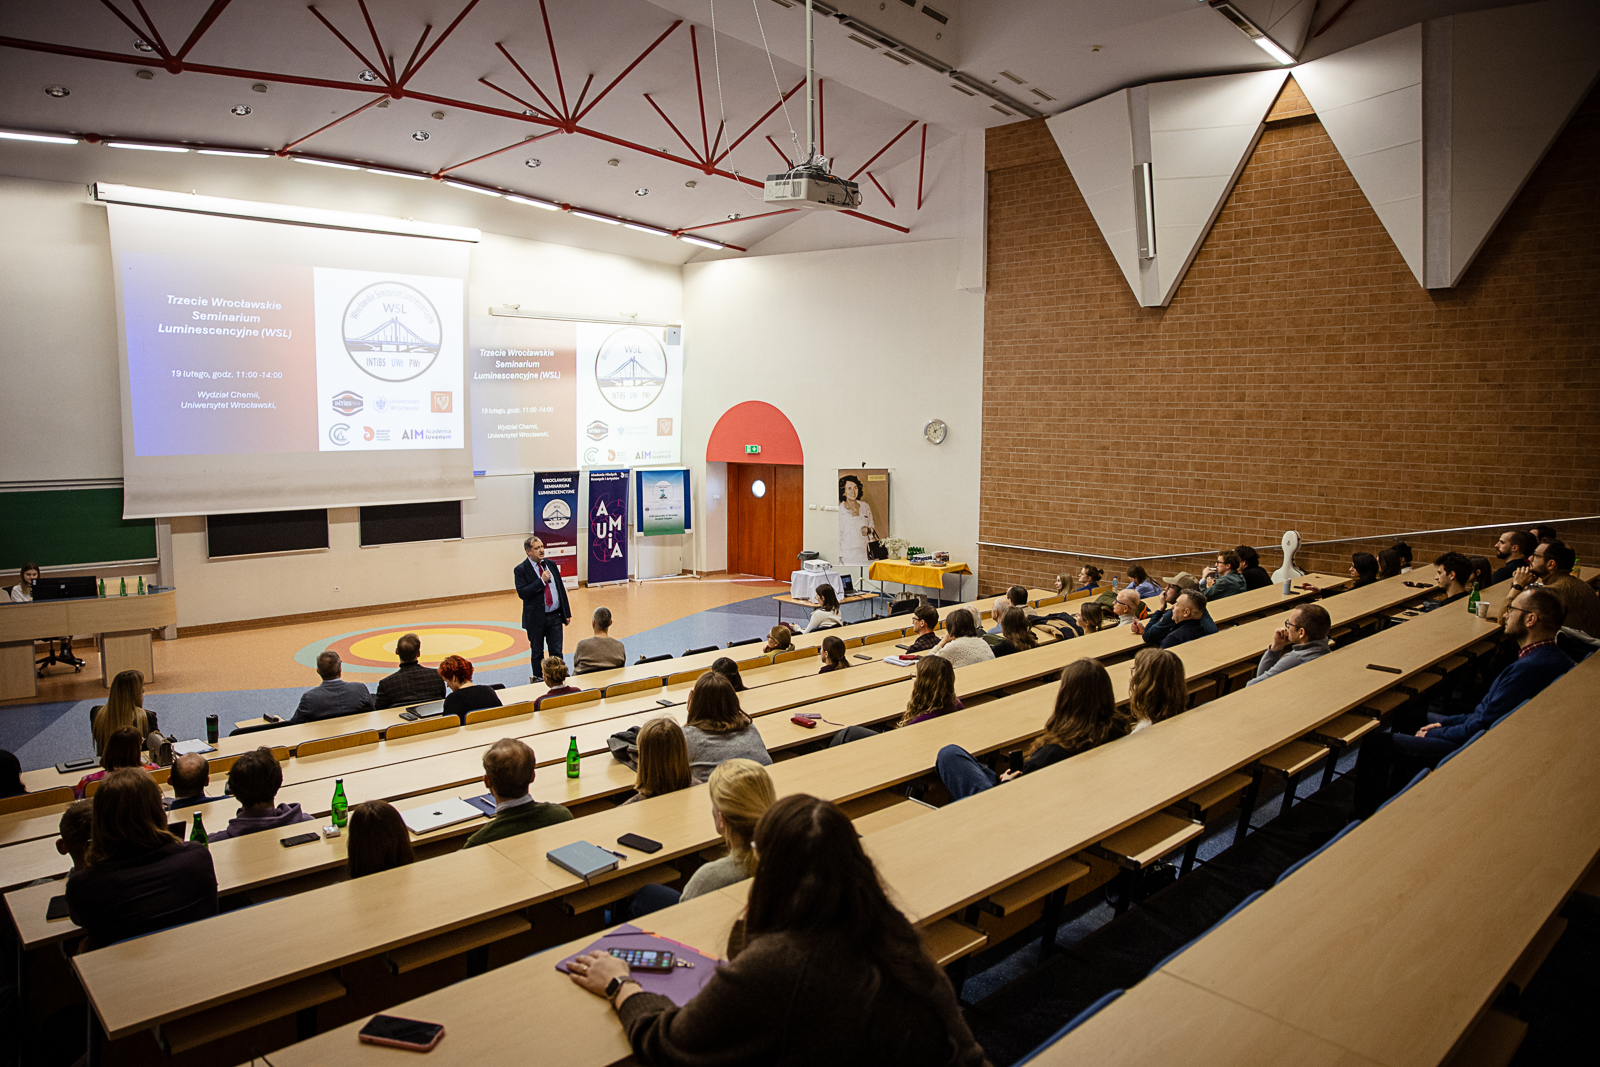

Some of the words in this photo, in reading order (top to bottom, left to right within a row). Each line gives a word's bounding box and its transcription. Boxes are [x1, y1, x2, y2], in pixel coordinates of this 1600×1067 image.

[166, 294, 209, 306] Trzecie
[210, 297, 282, 311] Wrocławskie
[382, 302, 408, 314] WSL
[191, 310, 261, 323] Seminarium
[157, 323, 259, 338] Luminescencyjne
[261, 327, 292, 340] (WSL)
[479, 348, 506, 357] Trzecie
[507, 348, 554, 357] Wrocławskie
[624, 345, 642, 354] WSL
[171, 369, 181, 378] 19
[183, 369, 211, 380] lutego,
[212, 370, 234, 380] godz.
[473, 371, 539, 381] Luminescencyjne
[539, 371, 561, 380] (WSL)
[197, 390, 230, 400] Wydział
[230, 390, 261, 400] Chemii,
[180, 401, 229, 411] Uniwersytet
[230, 401, 277, 410] Wrocławski,
[401, 429, 424, 440] AIM
[634, 450, 652, 460] AIM
